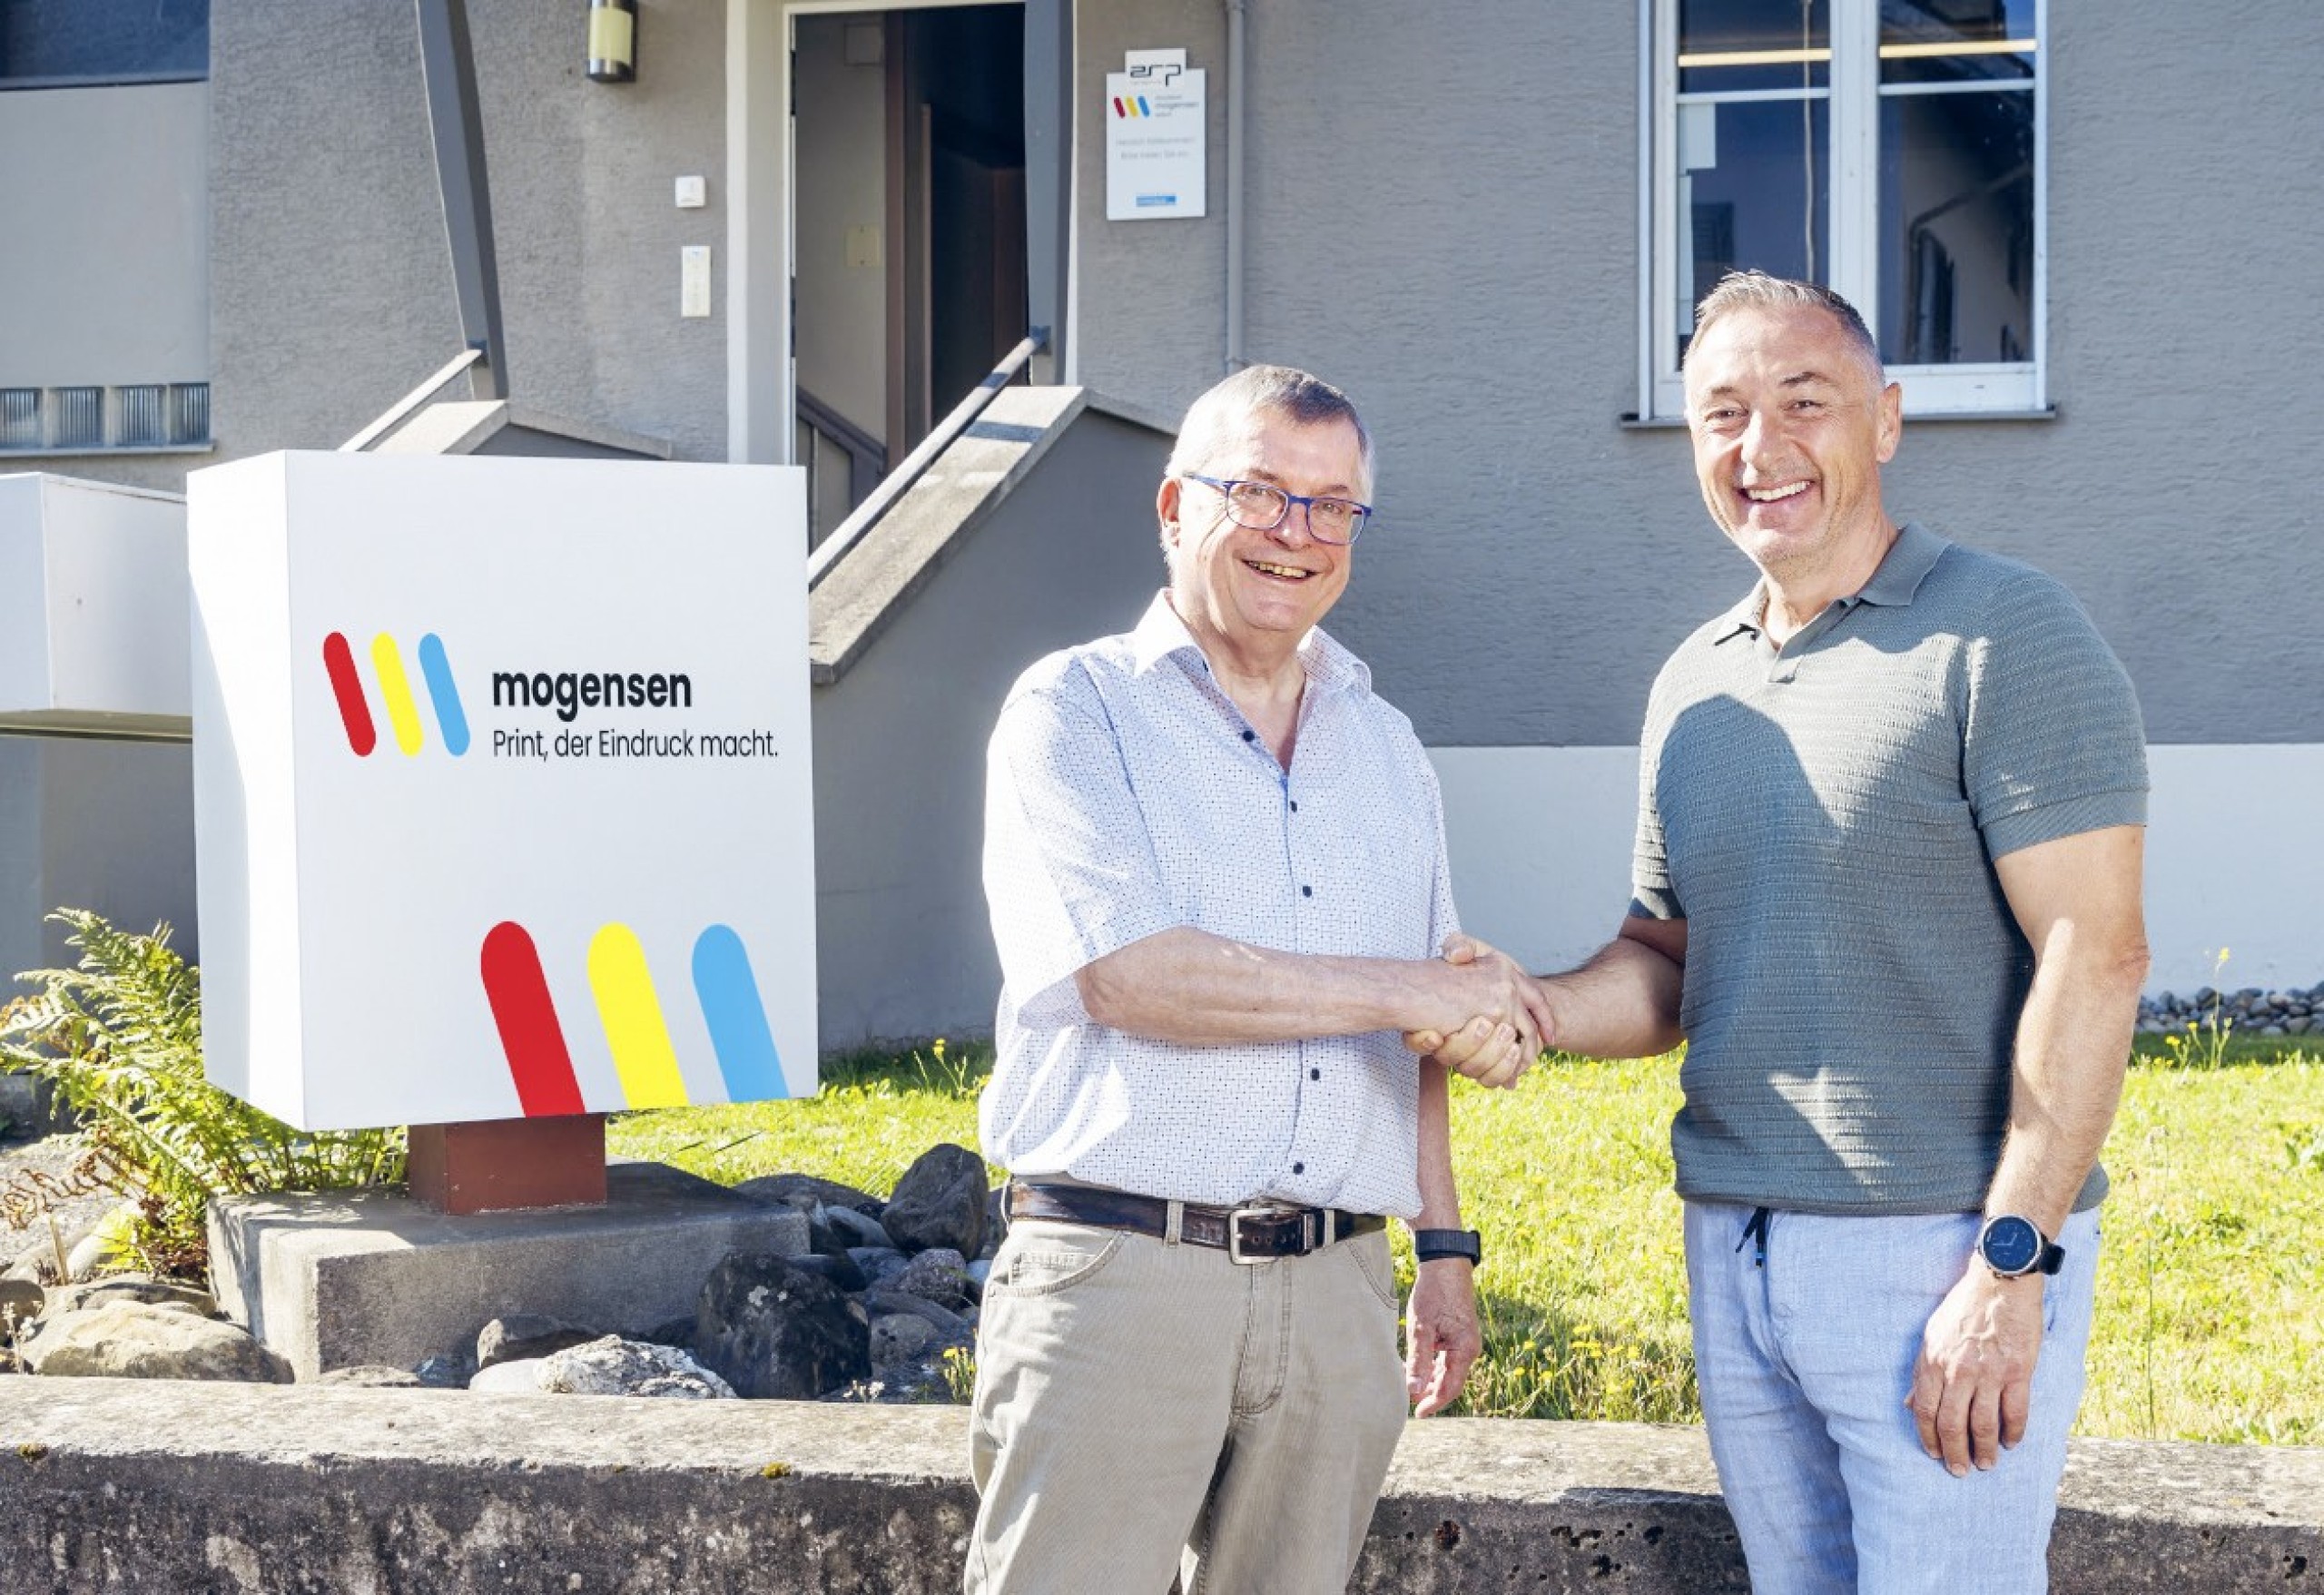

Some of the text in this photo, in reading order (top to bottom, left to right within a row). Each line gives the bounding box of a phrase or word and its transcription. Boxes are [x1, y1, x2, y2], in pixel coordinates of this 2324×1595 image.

[492, 672, 693, 722] mogensen
[493, 728, 779, 763] Print, der Eindruck macht.
